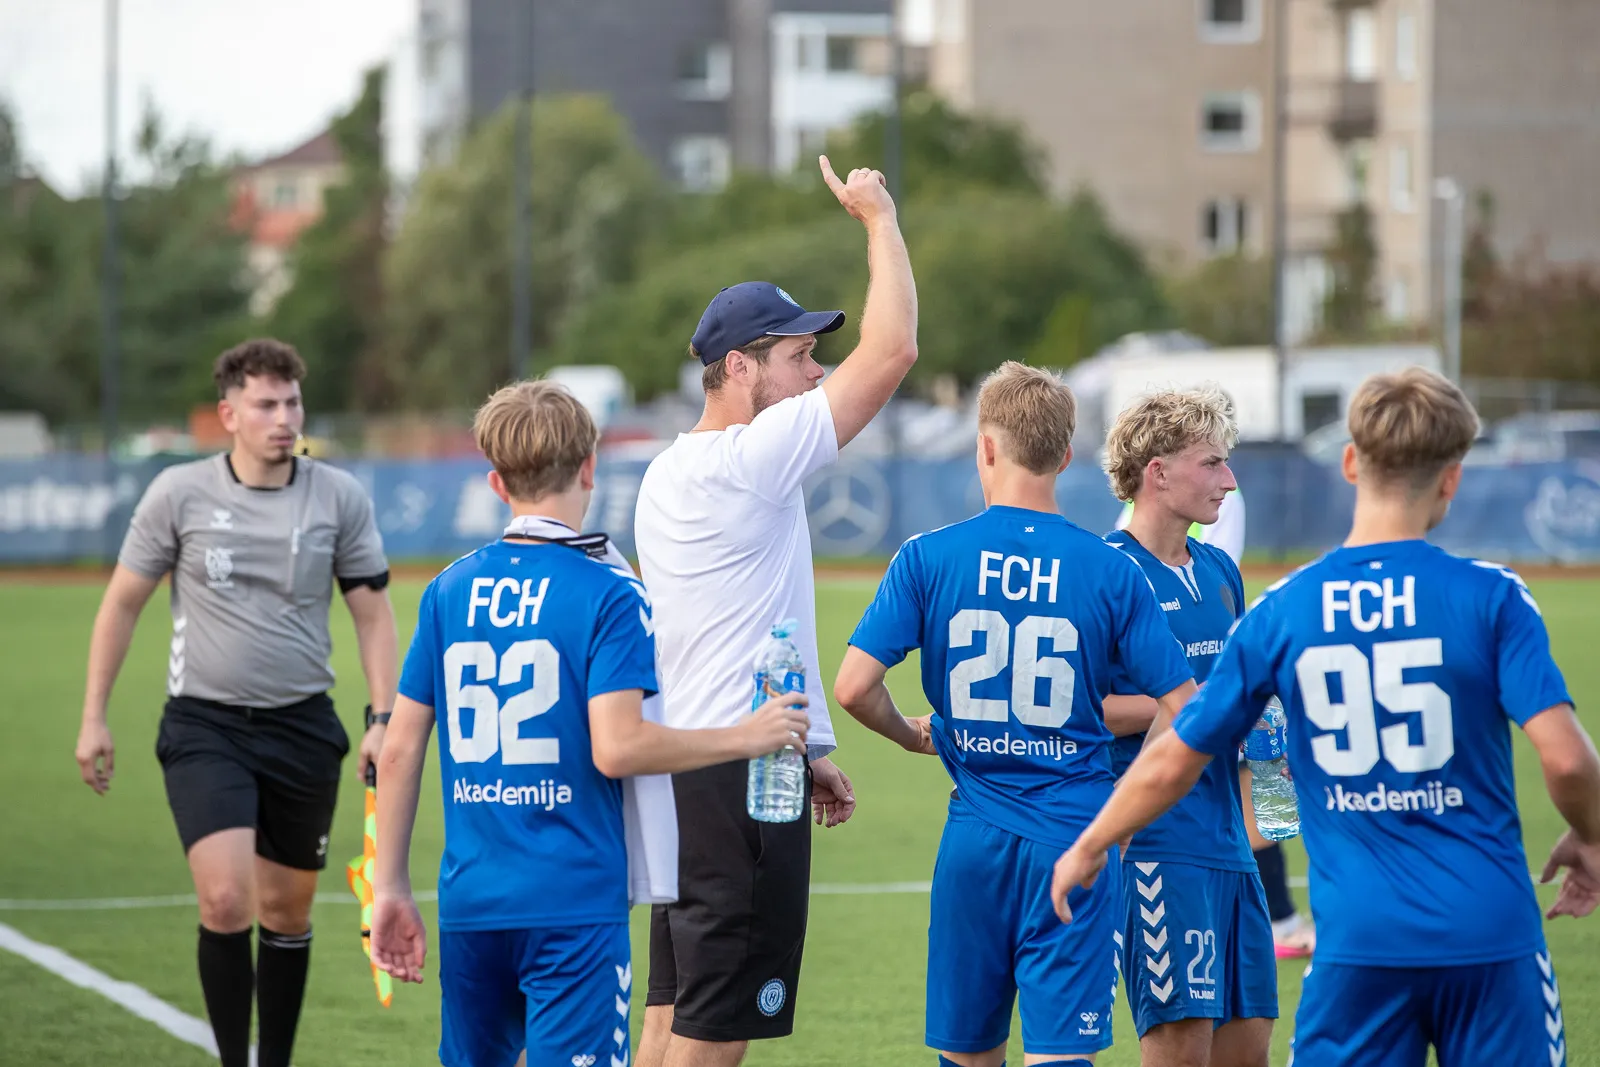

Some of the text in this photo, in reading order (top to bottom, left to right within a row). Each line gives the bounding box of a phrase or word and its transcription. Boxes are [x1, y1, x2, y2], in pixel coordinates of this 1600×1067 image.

[466, 577, 549, 628] FCH
[978, 550, 1060, 603] FCH
[1322, 574, 1416, 633] FCH
[948, 608, 1079, 729] 26
[443, 639, 560, 765] 62
[1295, 637, 1454, 777] 95
[453, 777, 572, 811] Akademija
[1185, 929, 1216, 985] 22
